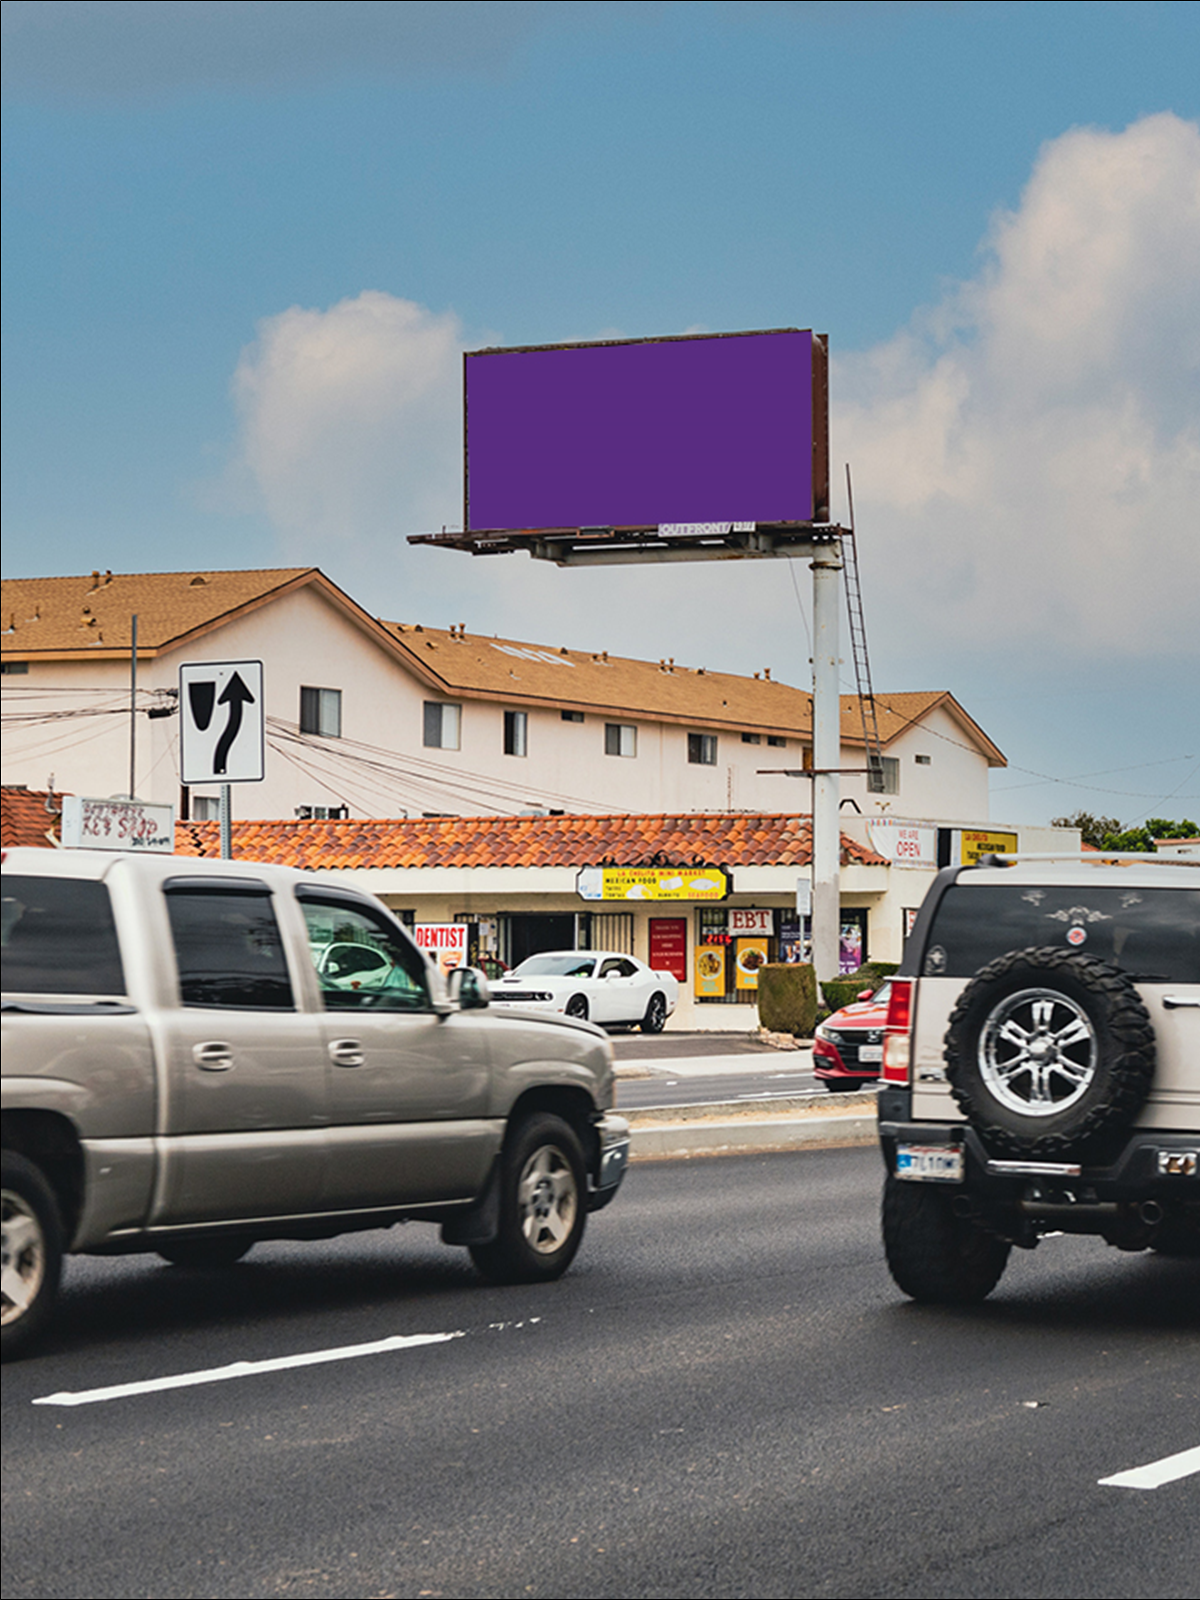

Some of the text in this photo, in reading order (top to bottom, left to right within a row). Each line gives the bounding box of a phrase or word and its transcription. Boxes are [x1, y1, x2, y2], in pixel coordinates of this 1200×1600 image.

[898, 830, 919, 840] WE ARE
[896, 841, 921, 857] OPEN
[678, 869, 706, 877] MARKET
[732, 910, 770, 929] EBT
[416, 927, 465, 948] DENTIST
